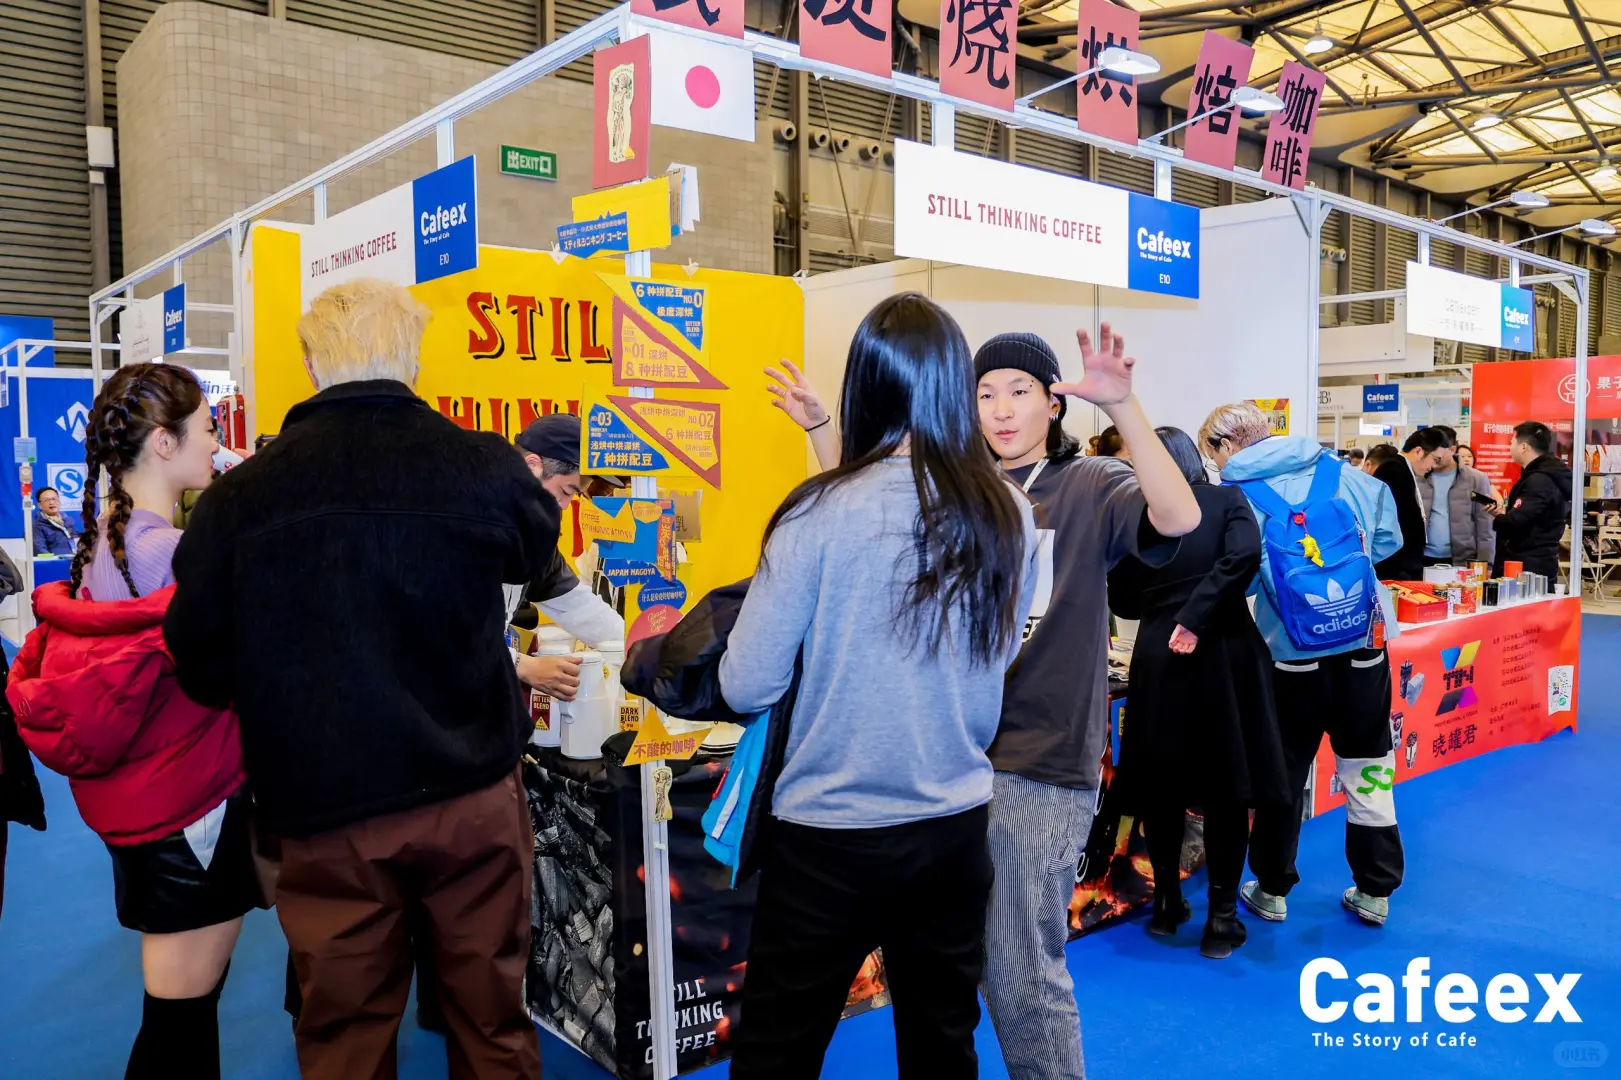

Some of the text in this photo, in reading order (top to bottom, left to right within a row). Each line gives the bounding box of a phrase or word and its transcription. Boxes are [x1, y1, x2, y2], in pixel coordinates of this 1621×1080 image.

[1270, 73, 1317, 187] 咖啡
[421, 202, 467, 237] Cafeex
[928, 193, 1102, 245] STILL THINKING COFFEE
[1137, 226, 1191, 259] Cafeex
[311, 231, 397, 278] STILL THINKING COFFEE
[439, 253, 449, 266] E10
[1159, 274, 1170, 285] E10
[636, 284, 645, 298] 6
[467, 291, 612, 364] STIL
[625, 361, 688, 379] 8 种拼配豆
[1366, 393, 1395, 402] Cafeex
[665, 428, 674, 441] 6
[591, 451, 653, 467] 7 种拼配豆
[607, 567, 656, 577] JAPAN NAGOYA
[1313, 610, 1368, 634] adidas
[533, 695, 551, 703] BITTER
[533, 702, 550, 710] BLEND
[620, 707, 639, 715] DARK
[620, 714, 639, 722] BLEND
[634, 737, 695, 759] 不酸的咖啡
[636, 1000, 725, 1040] TKING
